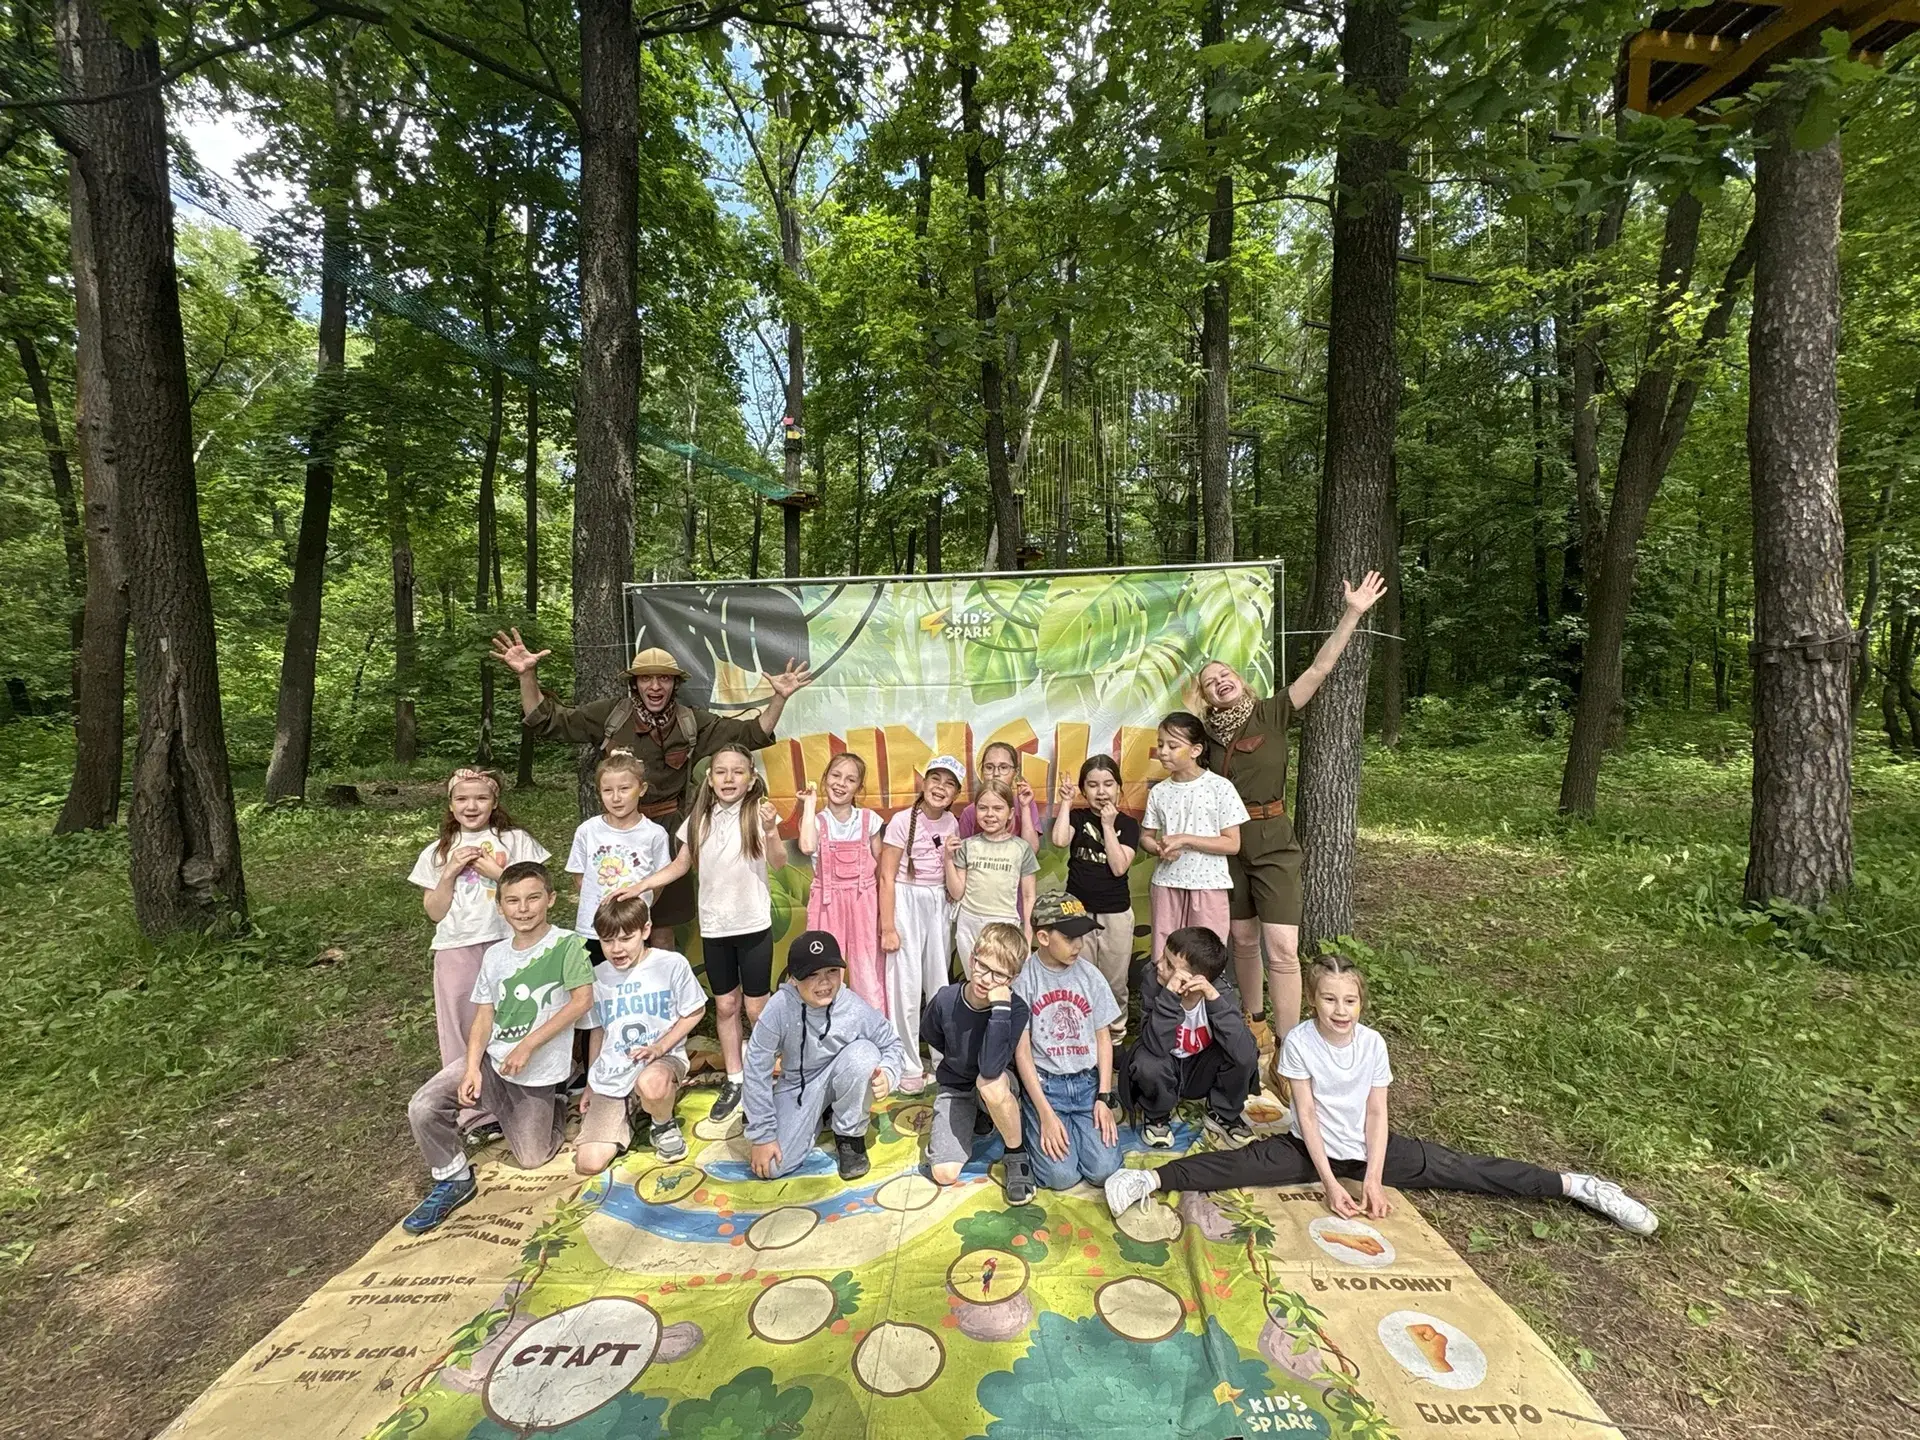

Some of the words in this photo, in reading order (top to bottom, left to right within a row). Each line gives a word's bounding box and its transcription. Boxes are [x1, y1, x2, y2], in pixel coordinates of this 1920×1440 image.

[952, 608, 996, 625] KID'S
[945, 626, 992, 640] SPARK
[616, 982, 641, 996] TOP
[1046, 1046, 1065, 1057] STAY
[482, 1171, 499, 1182] 2
[514, 1185, 547, 1193] НОГИ
[358, 1272, 381, 1287] 4
[388, 1274, 409, 1286] НЕ
[409, 1275, 476, 1286] БОЯТЬСЯ
[1312, 1279, 1328, 1292] В
[1333, 1277, 1452, 1292] КОЛОННУ
[347, 1291, 452, 1305] ТРУДНОСТЕЙ
[307, 1346, 351, 1359] БЫТЬ
[354, 1346, 419, 1359] ВСЕГДА
[512, 1342, 642, 1368] СТАРТ
[1249, 1391, 1308, 1414] KID'S
[1415, 1402, 1543, 1425] БЫСТРО
[1246, 1413, 1317, 1432] SPARK
